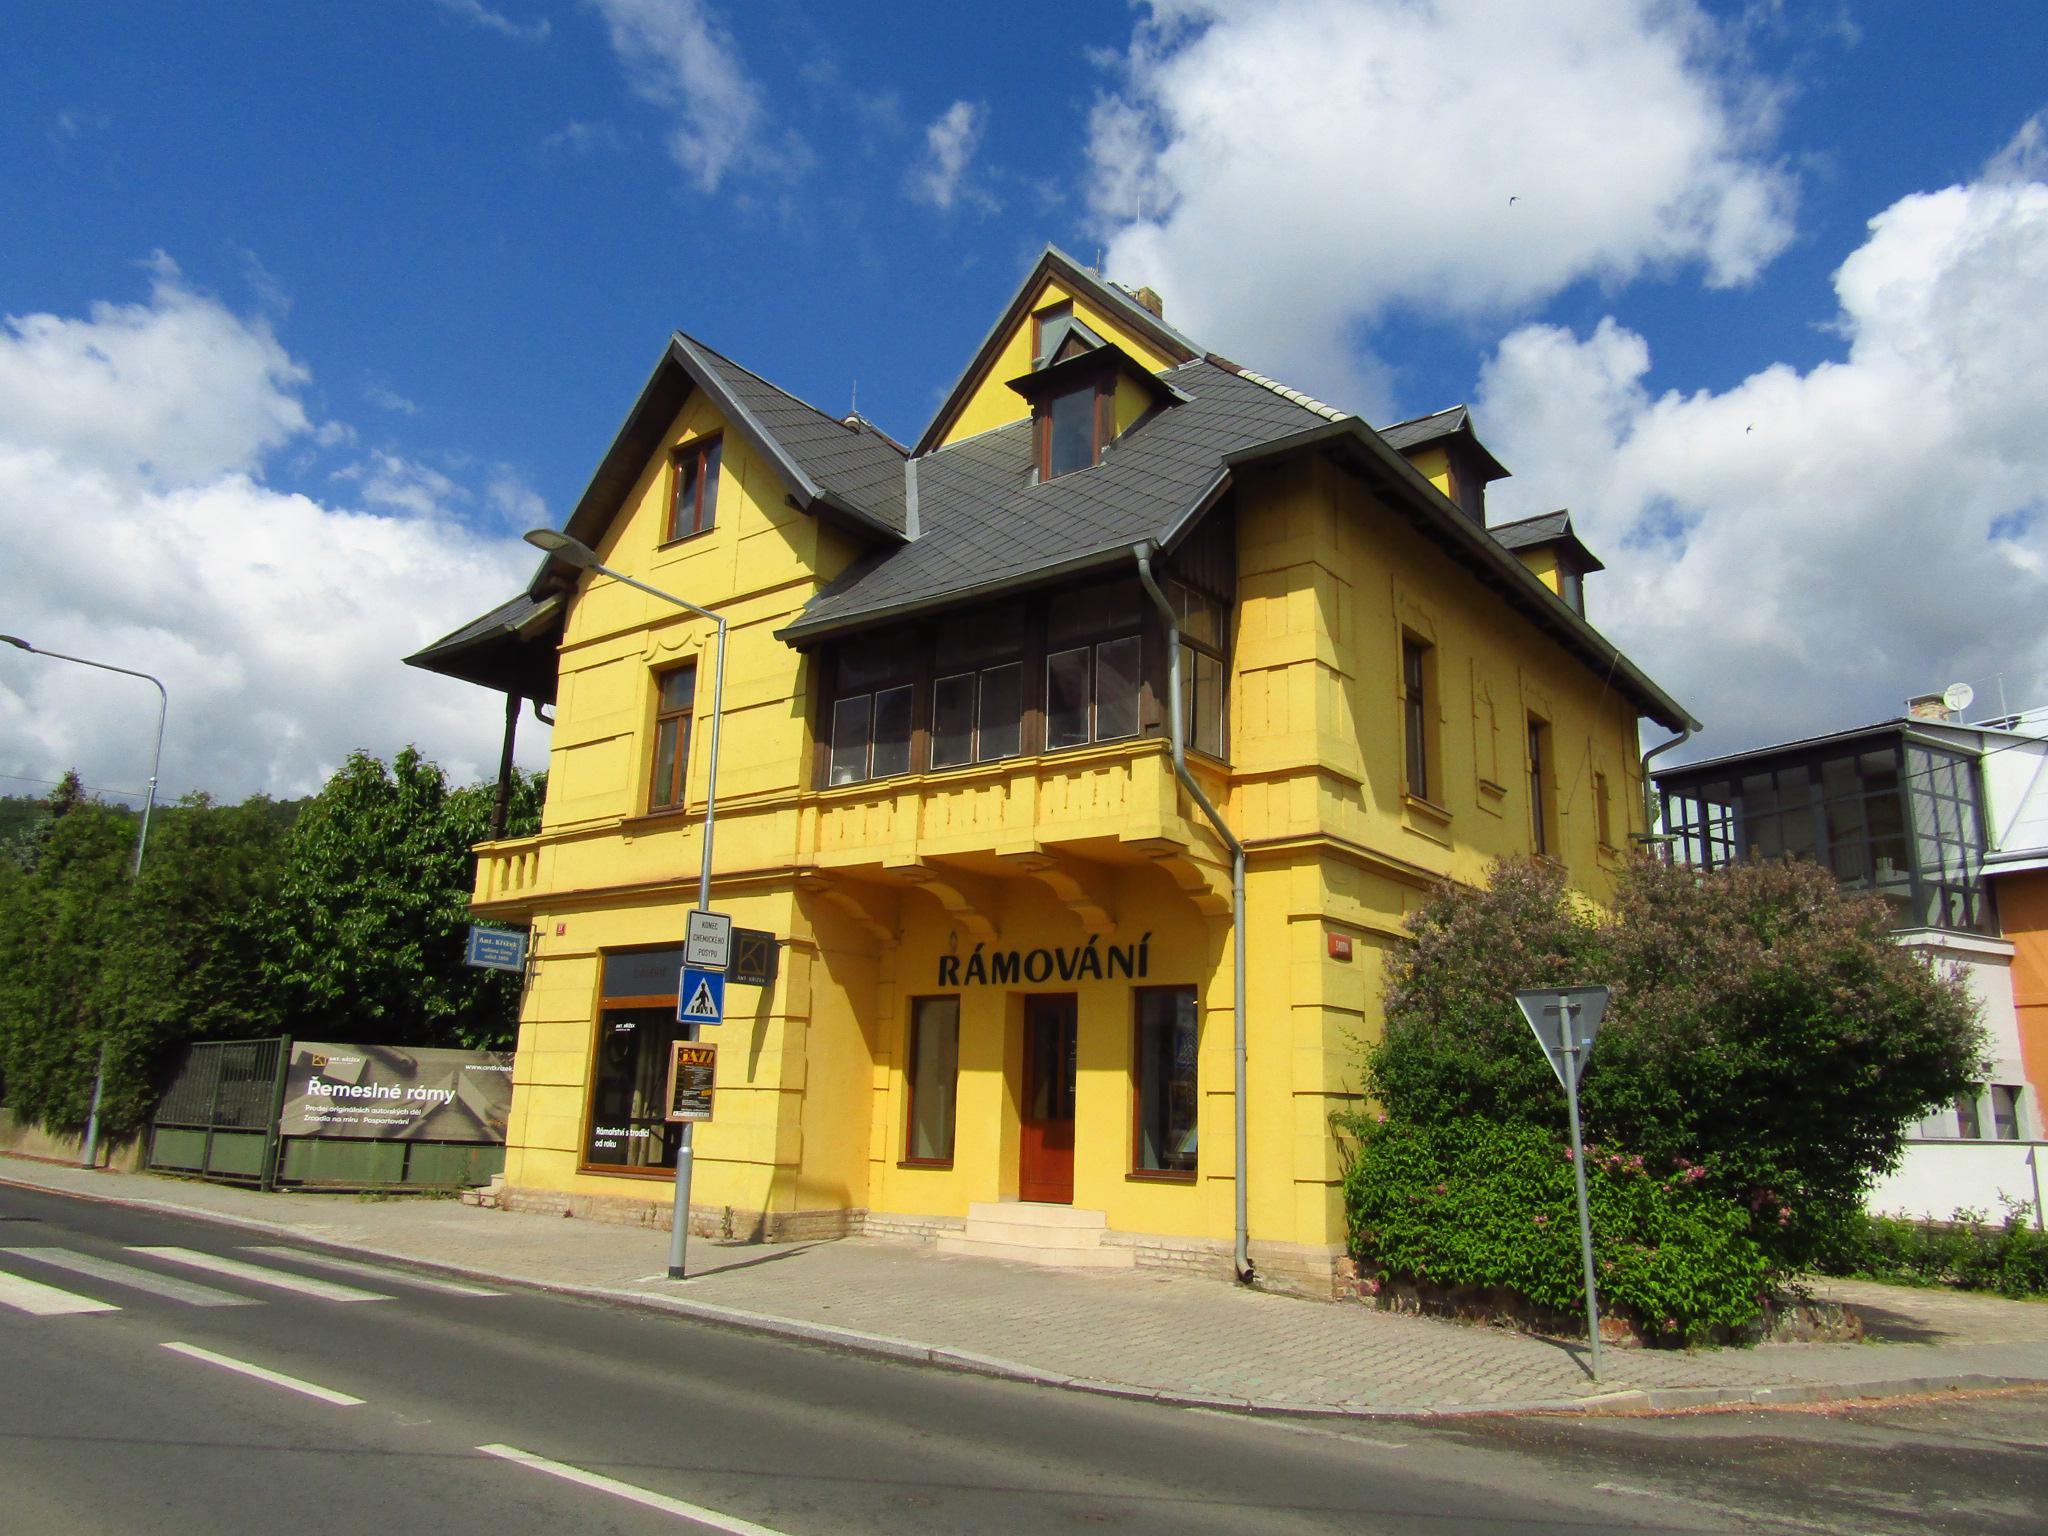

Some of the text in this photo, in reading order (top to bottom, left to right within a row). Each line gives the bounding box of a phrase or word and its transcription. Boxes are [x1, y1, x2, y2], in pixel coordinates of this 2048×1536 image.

[701, 921, 718, 930] KONEC
[692, 934, 724, 944] CHEMICKÉHO
[698, 948, 718, 958] POSYPU
[938, 932, 1152, 986] RÁMOVÁNÍ
[307, 1076, 456, 1105] Řemeslné rámy
[304, 1104, 328, 1112] Prodej
[329, 1105, 369, 1114] originálních
[371, 1107, 409, 1116] autorských
[596, 1126, 625, 1136] Rámařství
[629, 1128, 650, 1138] tradicí
[594, 1139, 604, 1148] od
